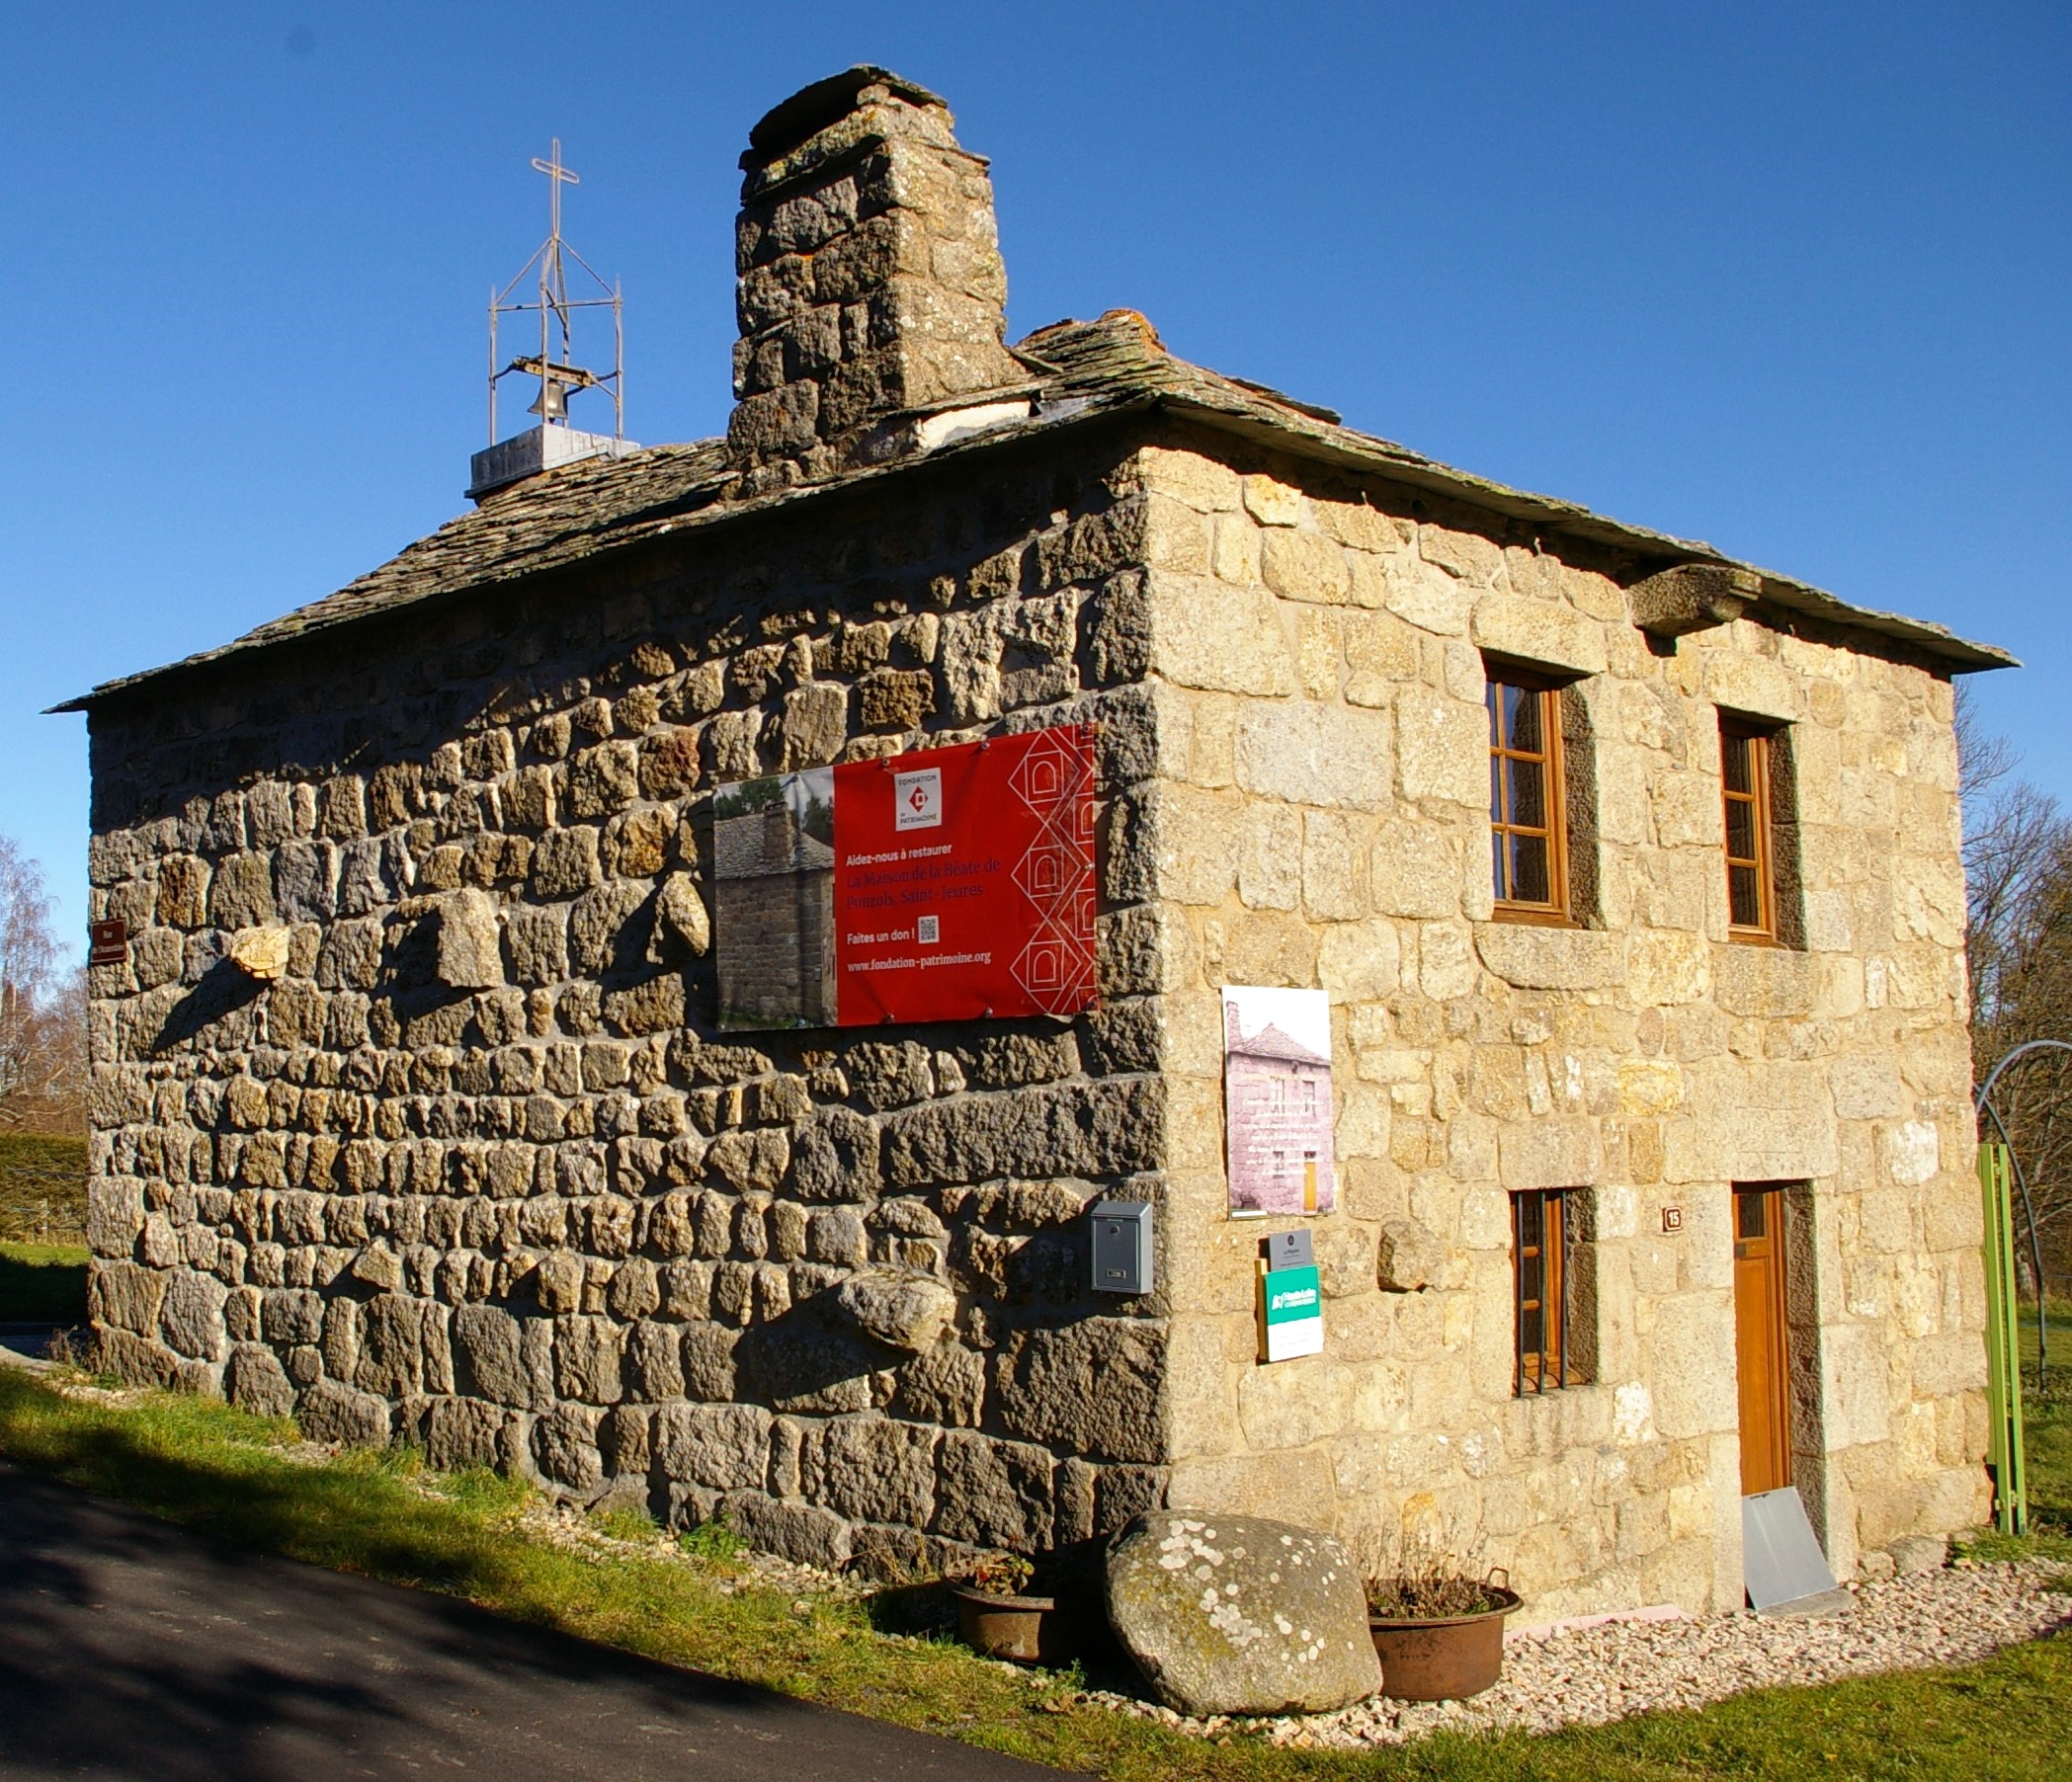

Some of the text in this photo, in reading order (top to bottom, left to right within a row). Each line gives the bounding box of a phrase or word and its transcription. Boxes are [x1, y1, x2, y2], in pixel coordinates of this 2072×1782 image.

[899, 774, 937, 785] FONDATION
[846, 844, 953, 866] Aidez-nous à restaurer
[847, 875, 861, 888] La
[864, 870, 909, 886] Maison
[912, 865, 927, 880] de
[930, 863, 941, 878] la
[983, 855, 1000, 872] de
[847, 932, 874, 944] Faites
[876, 932, 888, 942] un
[890, 929, 909, 941] don
[847, 951, 991, 972] www.fondation-patrimoine.org
[1669, 1211, 1680, 1226] 15
